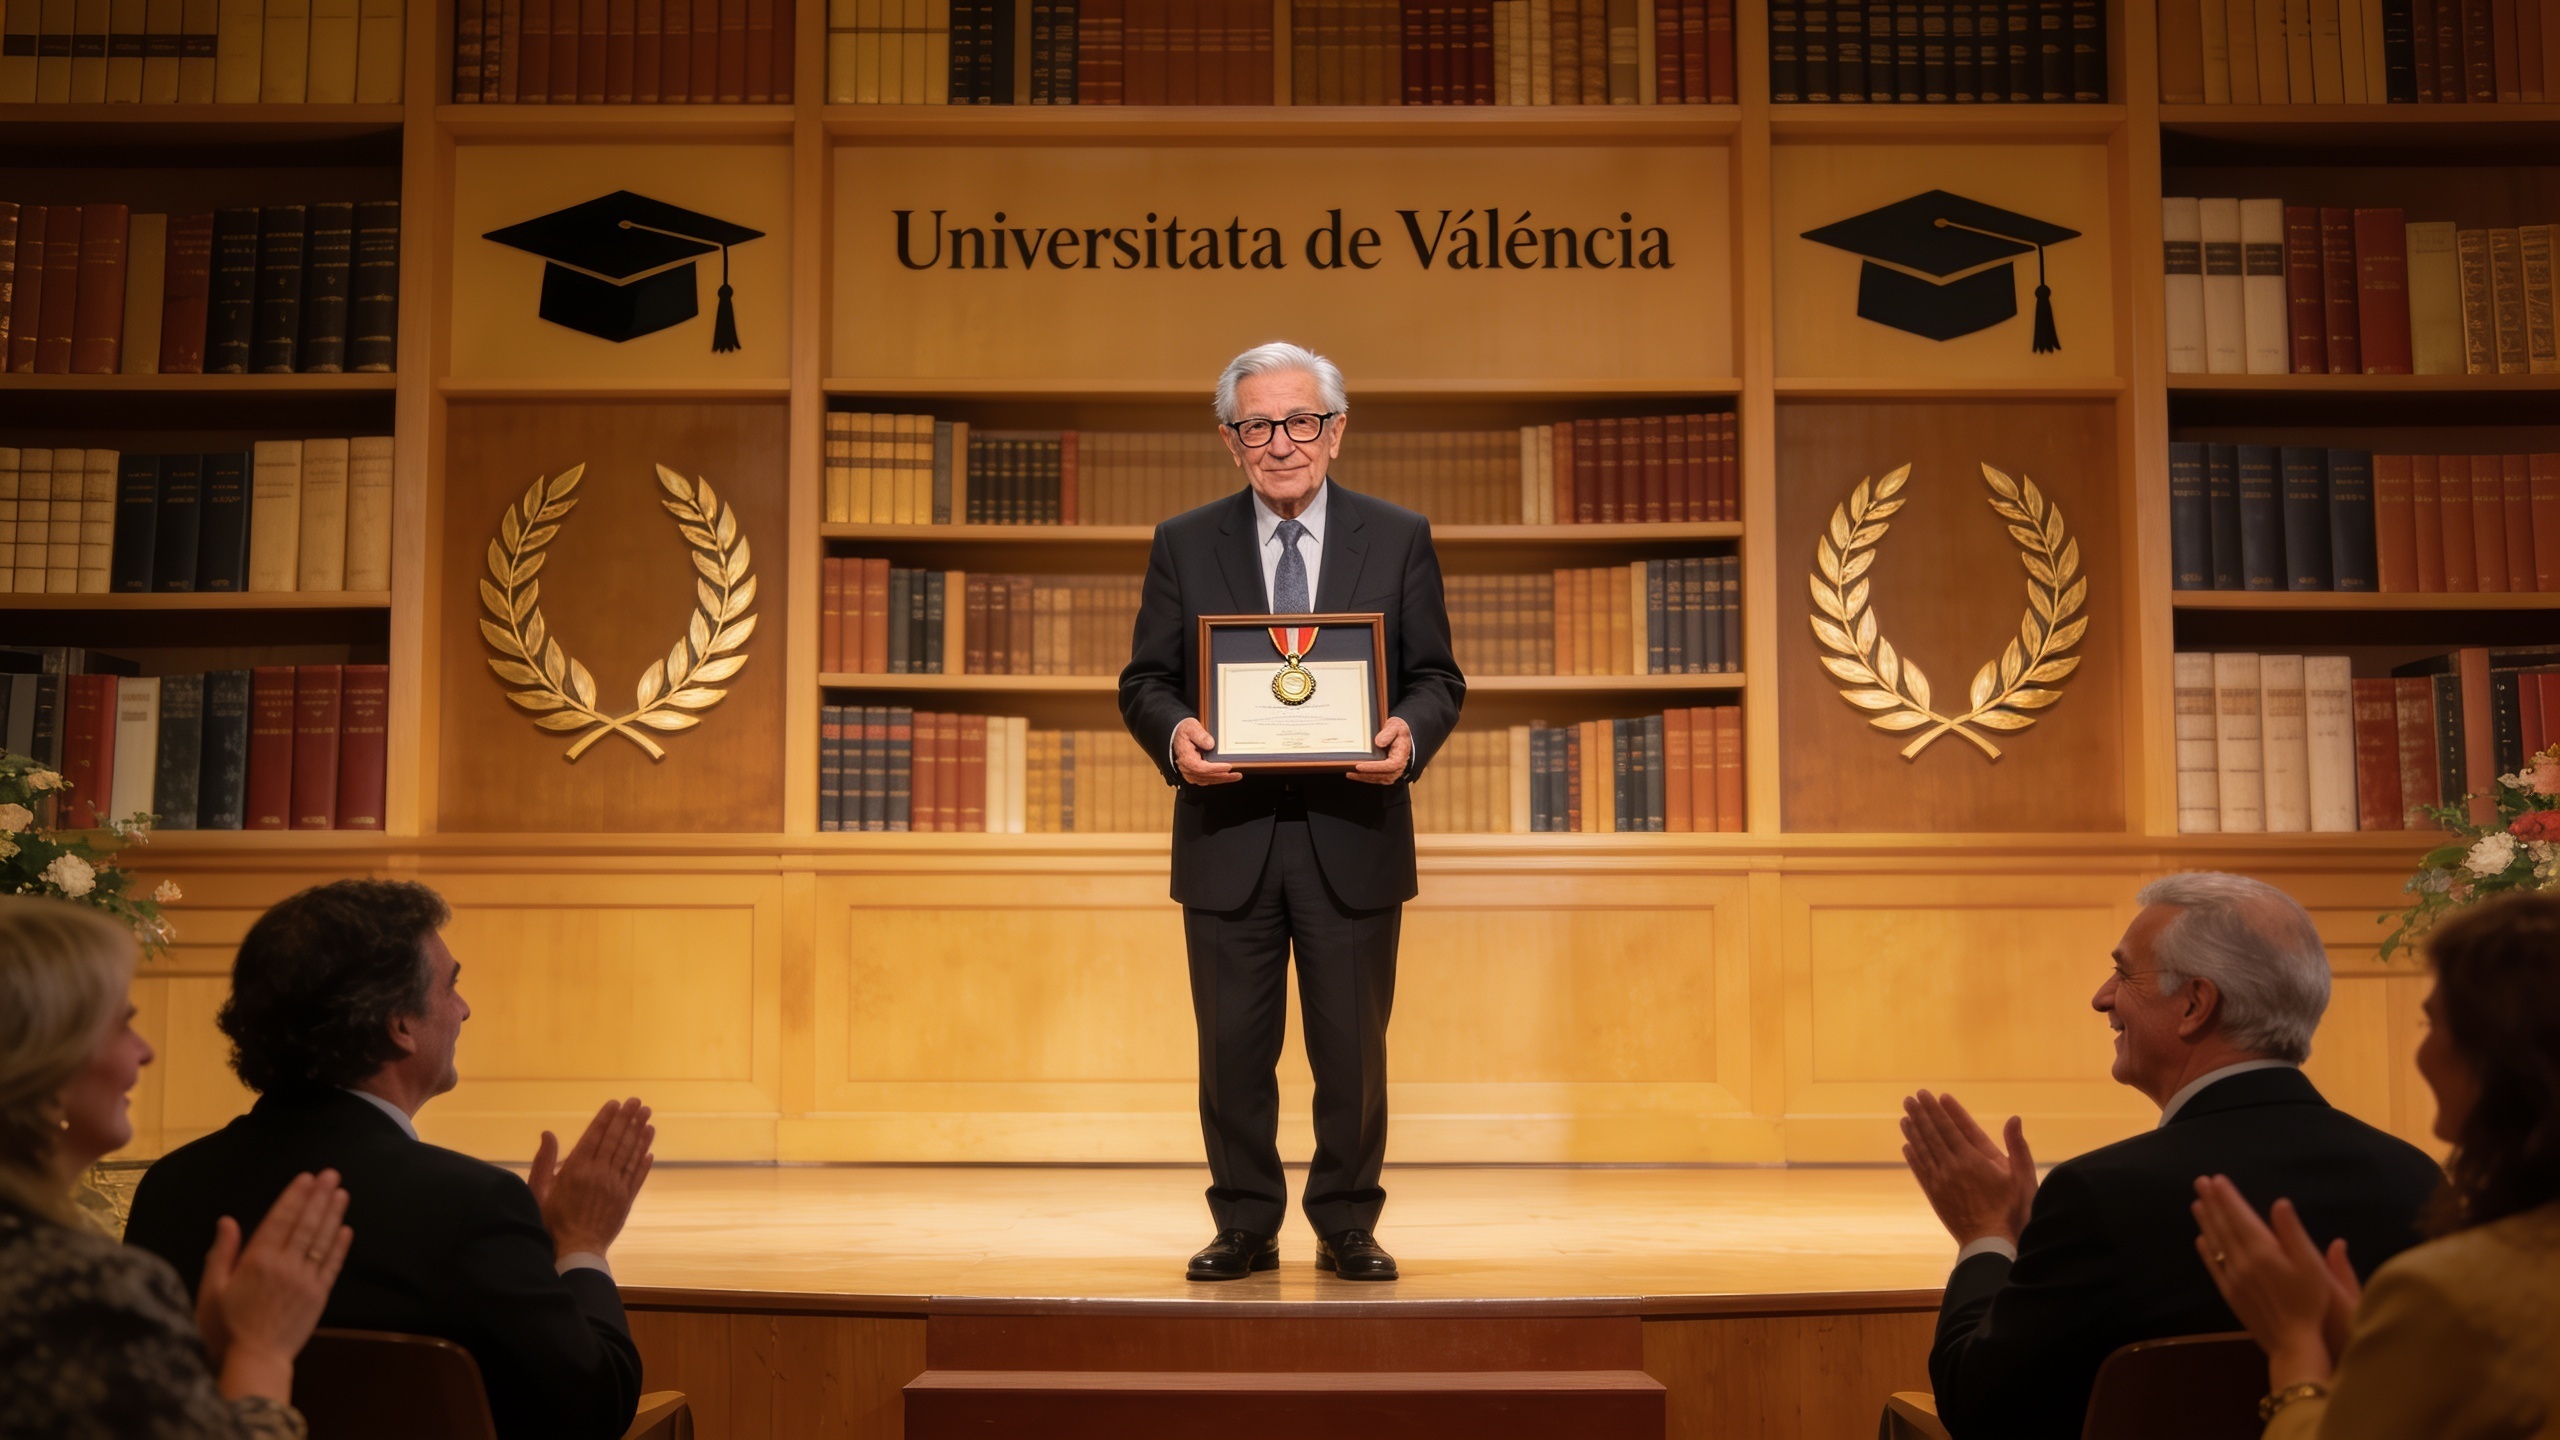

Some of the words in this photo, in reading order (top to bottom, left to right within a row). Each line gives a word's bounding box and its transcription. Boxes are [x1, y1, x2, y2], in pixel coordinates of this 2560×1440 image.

[890, 208, 1288, 271] Universitata
[1304, 207, 1382, 271] de
[1393, 207, 1677, 271] Váléncia
